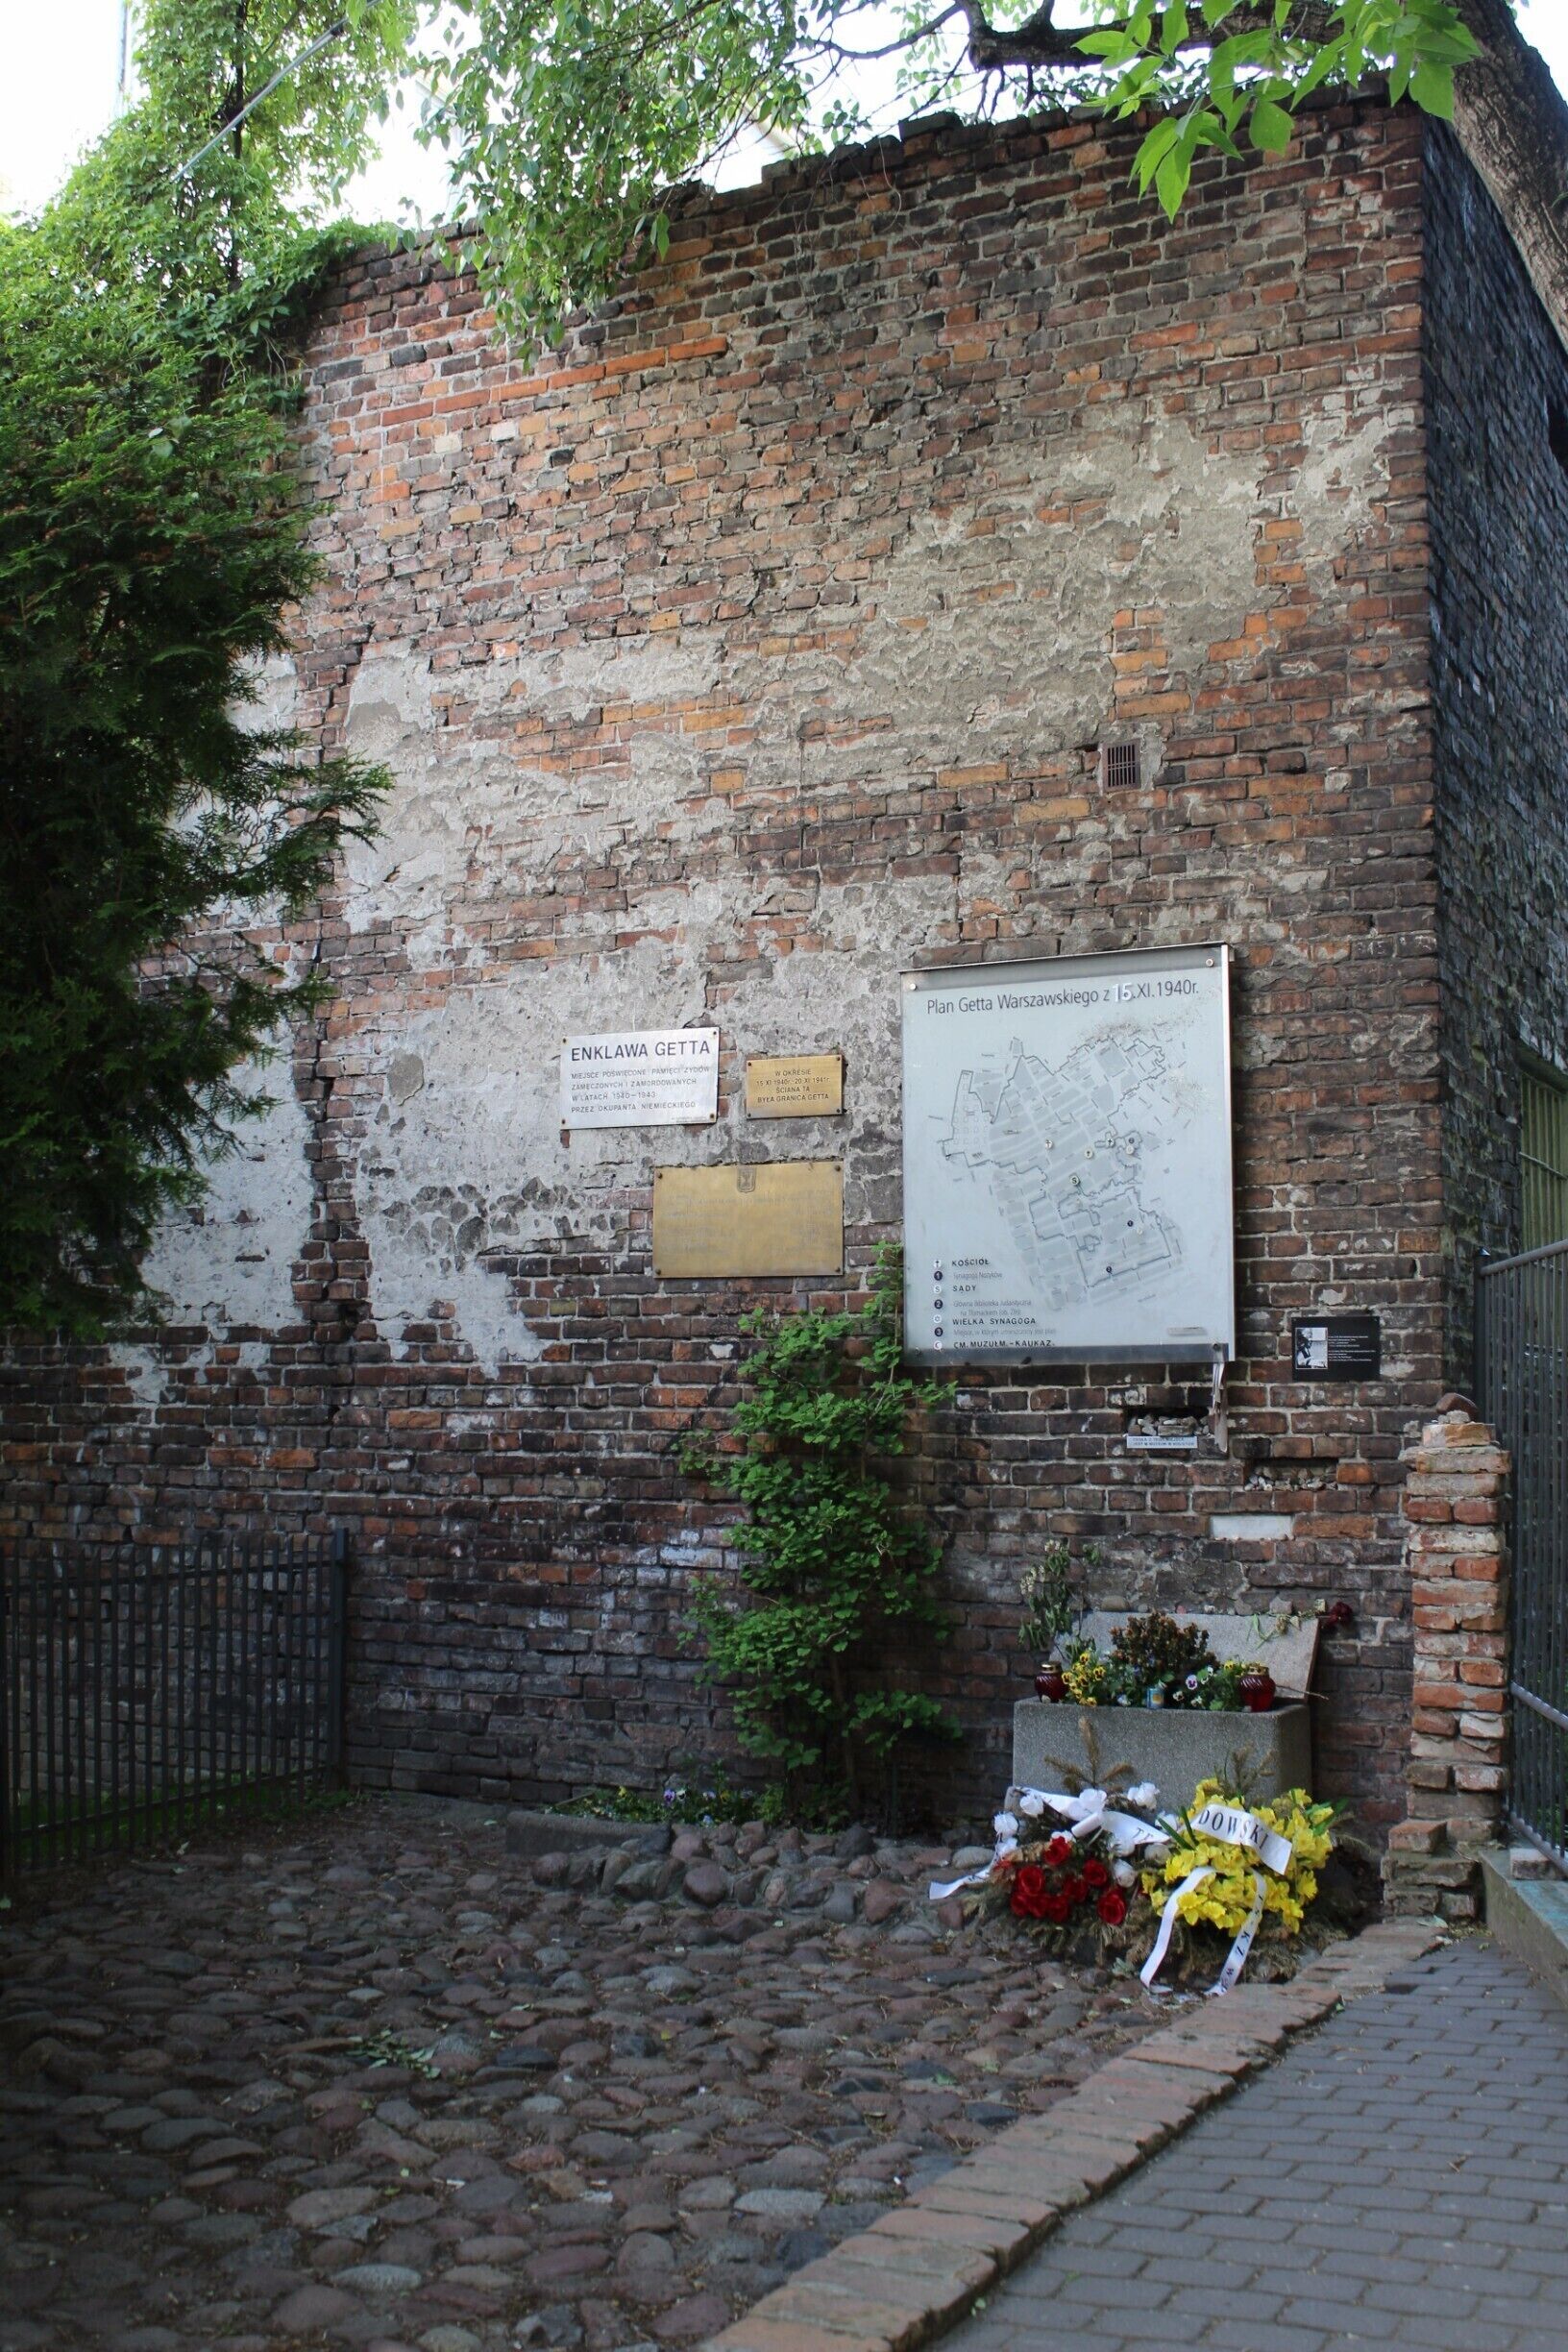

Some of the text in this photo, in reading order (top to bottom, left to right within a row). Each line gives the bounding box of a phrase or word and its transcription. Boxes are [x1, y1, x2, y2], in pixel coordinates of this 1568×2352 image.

[927, 998, 954, 1014] Plan
[959, 997, 992, 1012] Getta
[996, 989, 1099, 1009] Warszawskiego
[1103, 990, 1110, 1001] z
[572, 1041, 710, 1062] ENKLAWA GETTA
[630, 1078, 697, 1088] ZAMORDOWANYCH
[641, 1101, 697, 1110] NIEMIECKIEGO
[952, 1286, 977, 1294] SĄDY
[952, 1317, 1036, 1326] WIELKA SYNAGOGA
